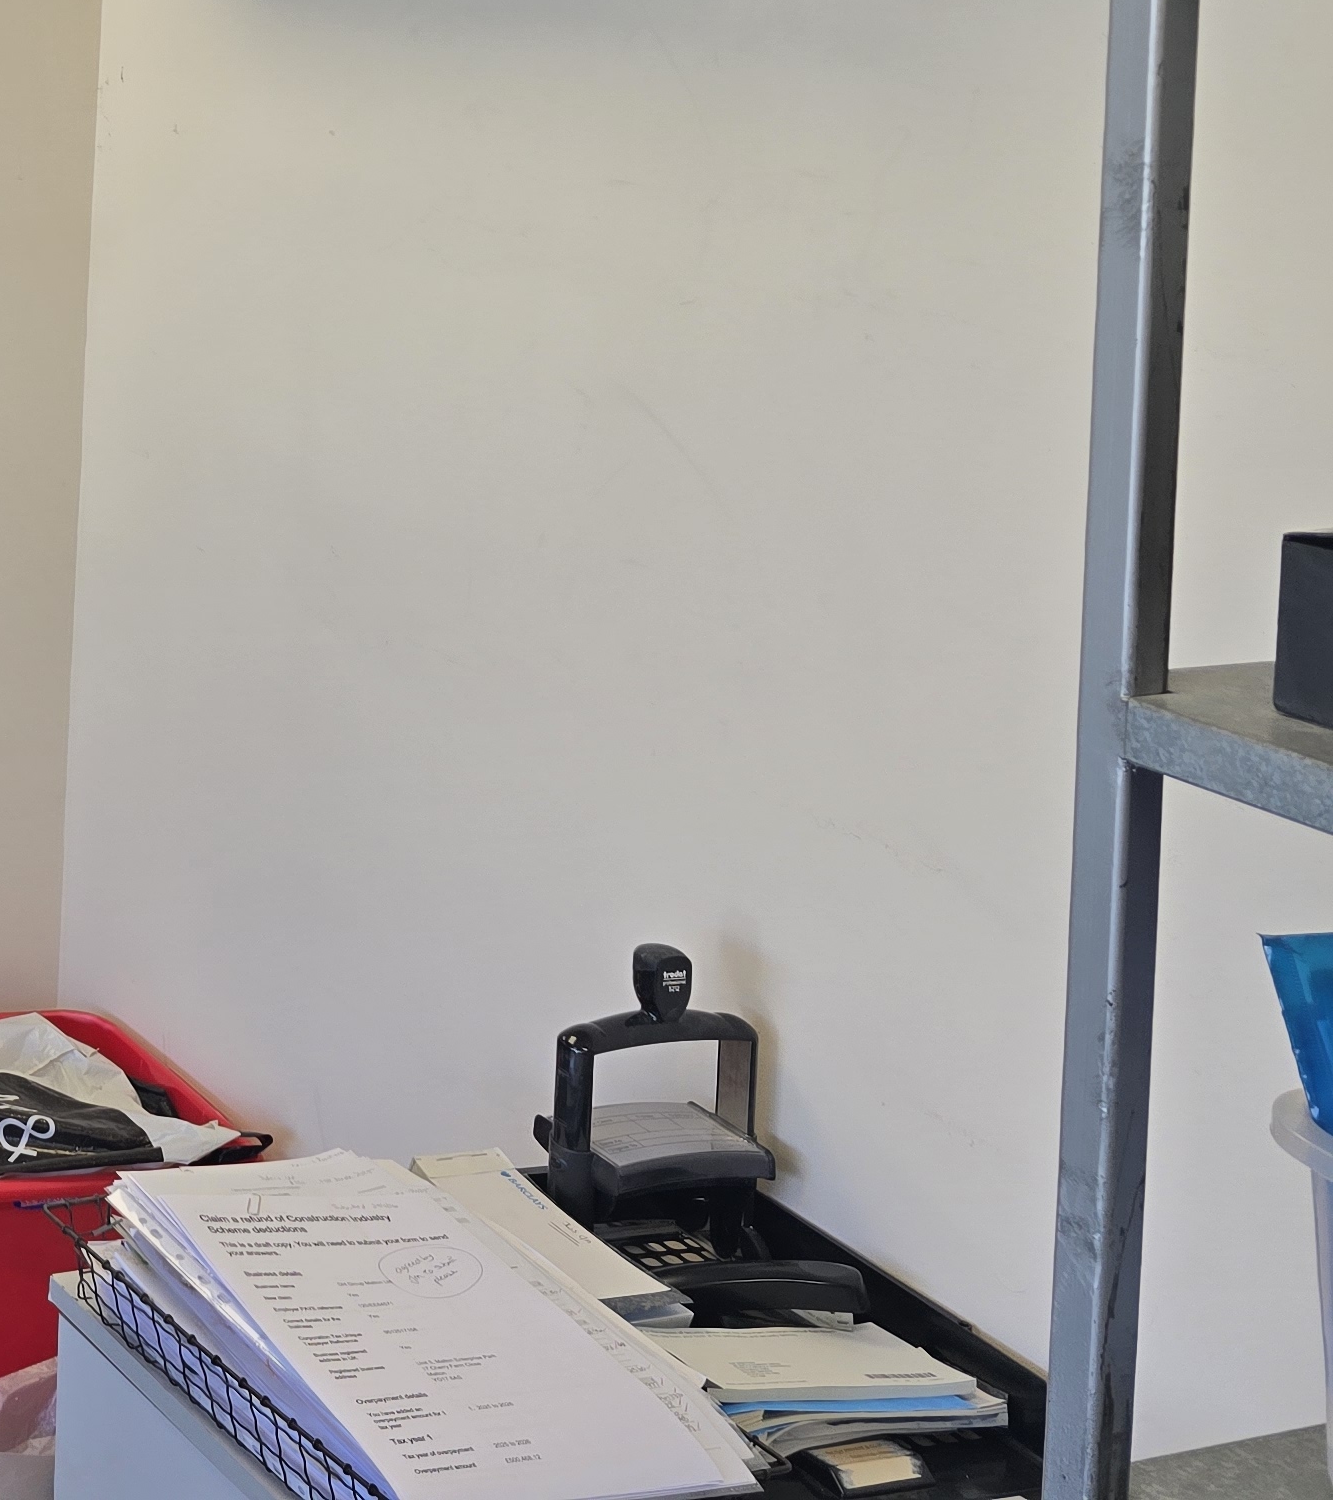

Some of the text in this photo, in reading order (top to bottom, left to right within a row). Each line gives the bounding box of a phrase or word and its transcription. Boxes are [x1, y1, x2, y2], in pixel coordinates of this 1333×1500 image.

[508, 1177, 549, 1211] BARCLAYS
[199, 1214, 228, 1222] Claim
[239, 1215, 273, 1223] refund
[275, 1214, 286, 1222] of
[286, 1214, 349, 1222] Construction
[349, 1214, 392, 1222] Industry
[208, 1225, 250, 1233] Scheme
[429, 1233, 449, 1241] send
[356, 1394, 405, 1405] Overpayment
[390, 1437, 406, 1445] Tax
[408, 1435, 426, 1443] year
[436, 1446, 474, 1456] overpayment
[414, 1464, 454, 1475] Overpayment
